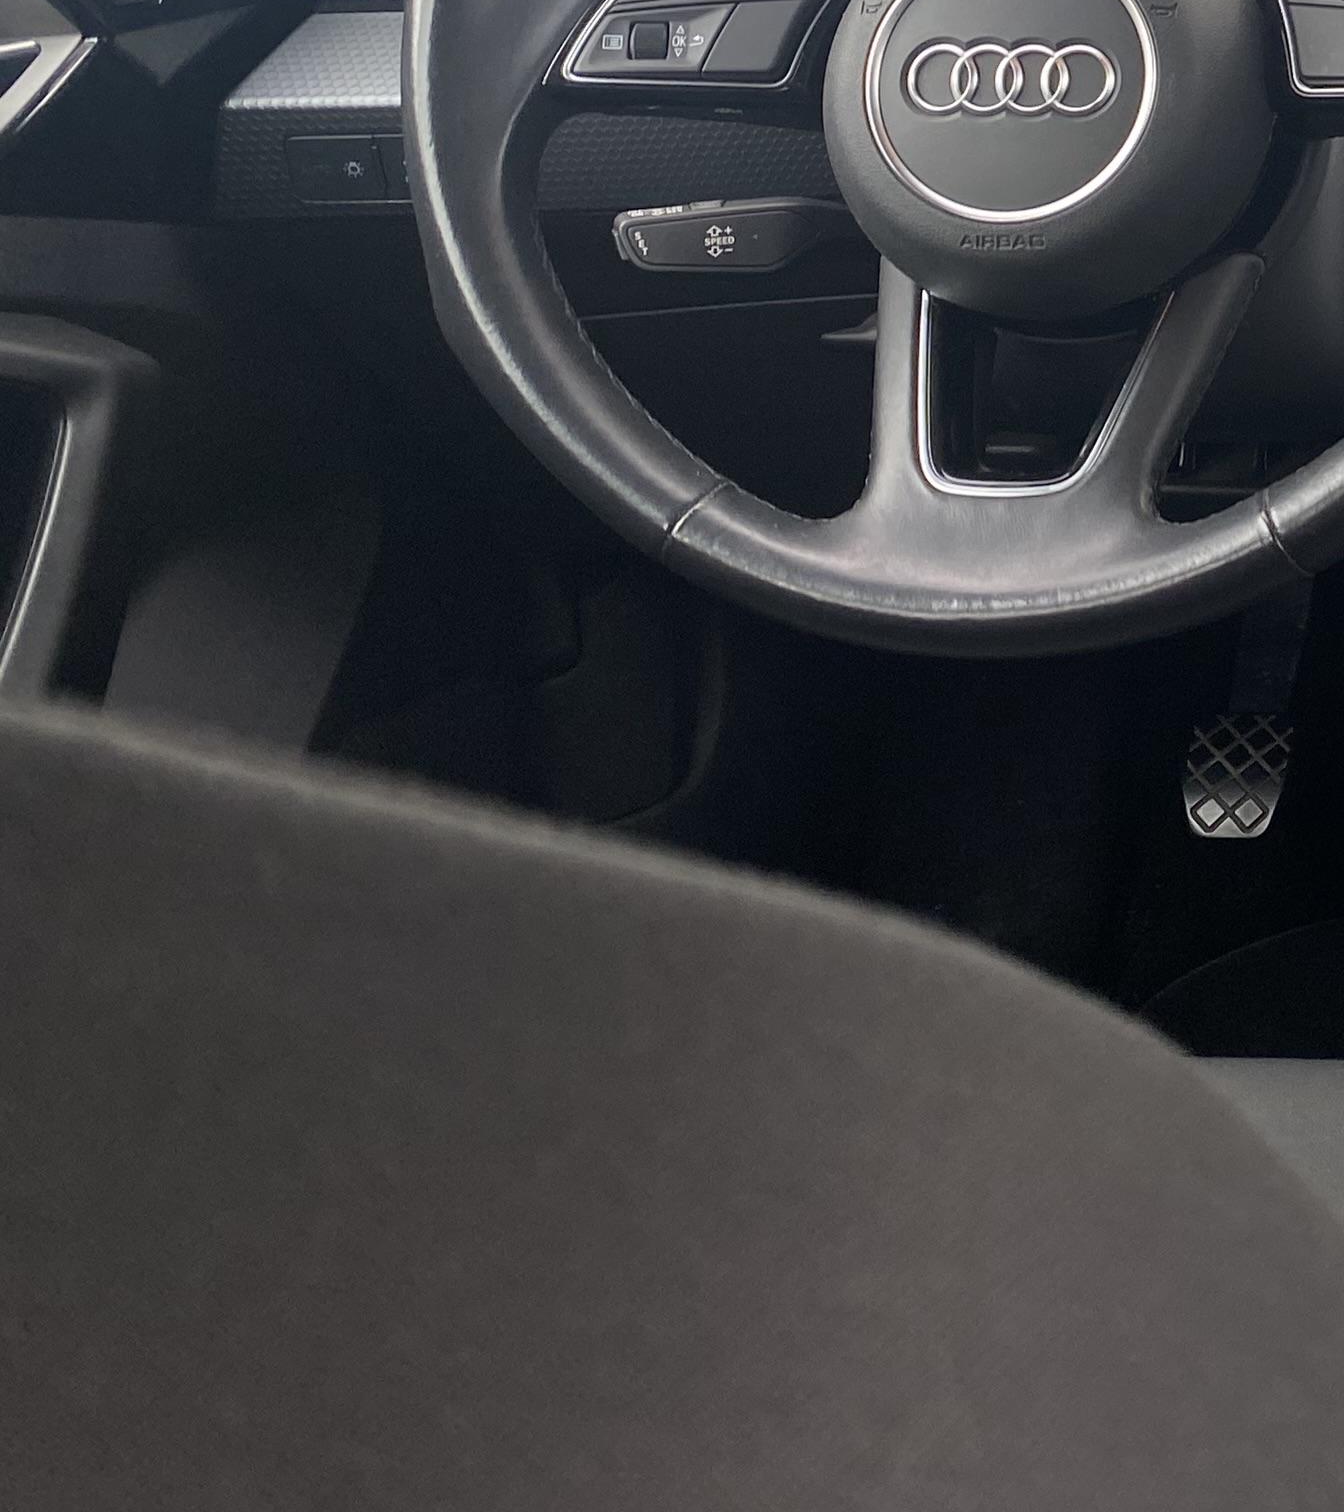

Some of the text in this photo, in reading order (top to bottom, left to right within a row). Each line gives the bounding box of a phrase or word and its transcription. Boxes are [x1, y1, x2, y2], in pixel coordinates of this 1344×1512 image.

[672, 35, 687, 47] OK
[704, 236, 735, 246] SPEED
[960, 234, 1046, 249] AIRBAG
